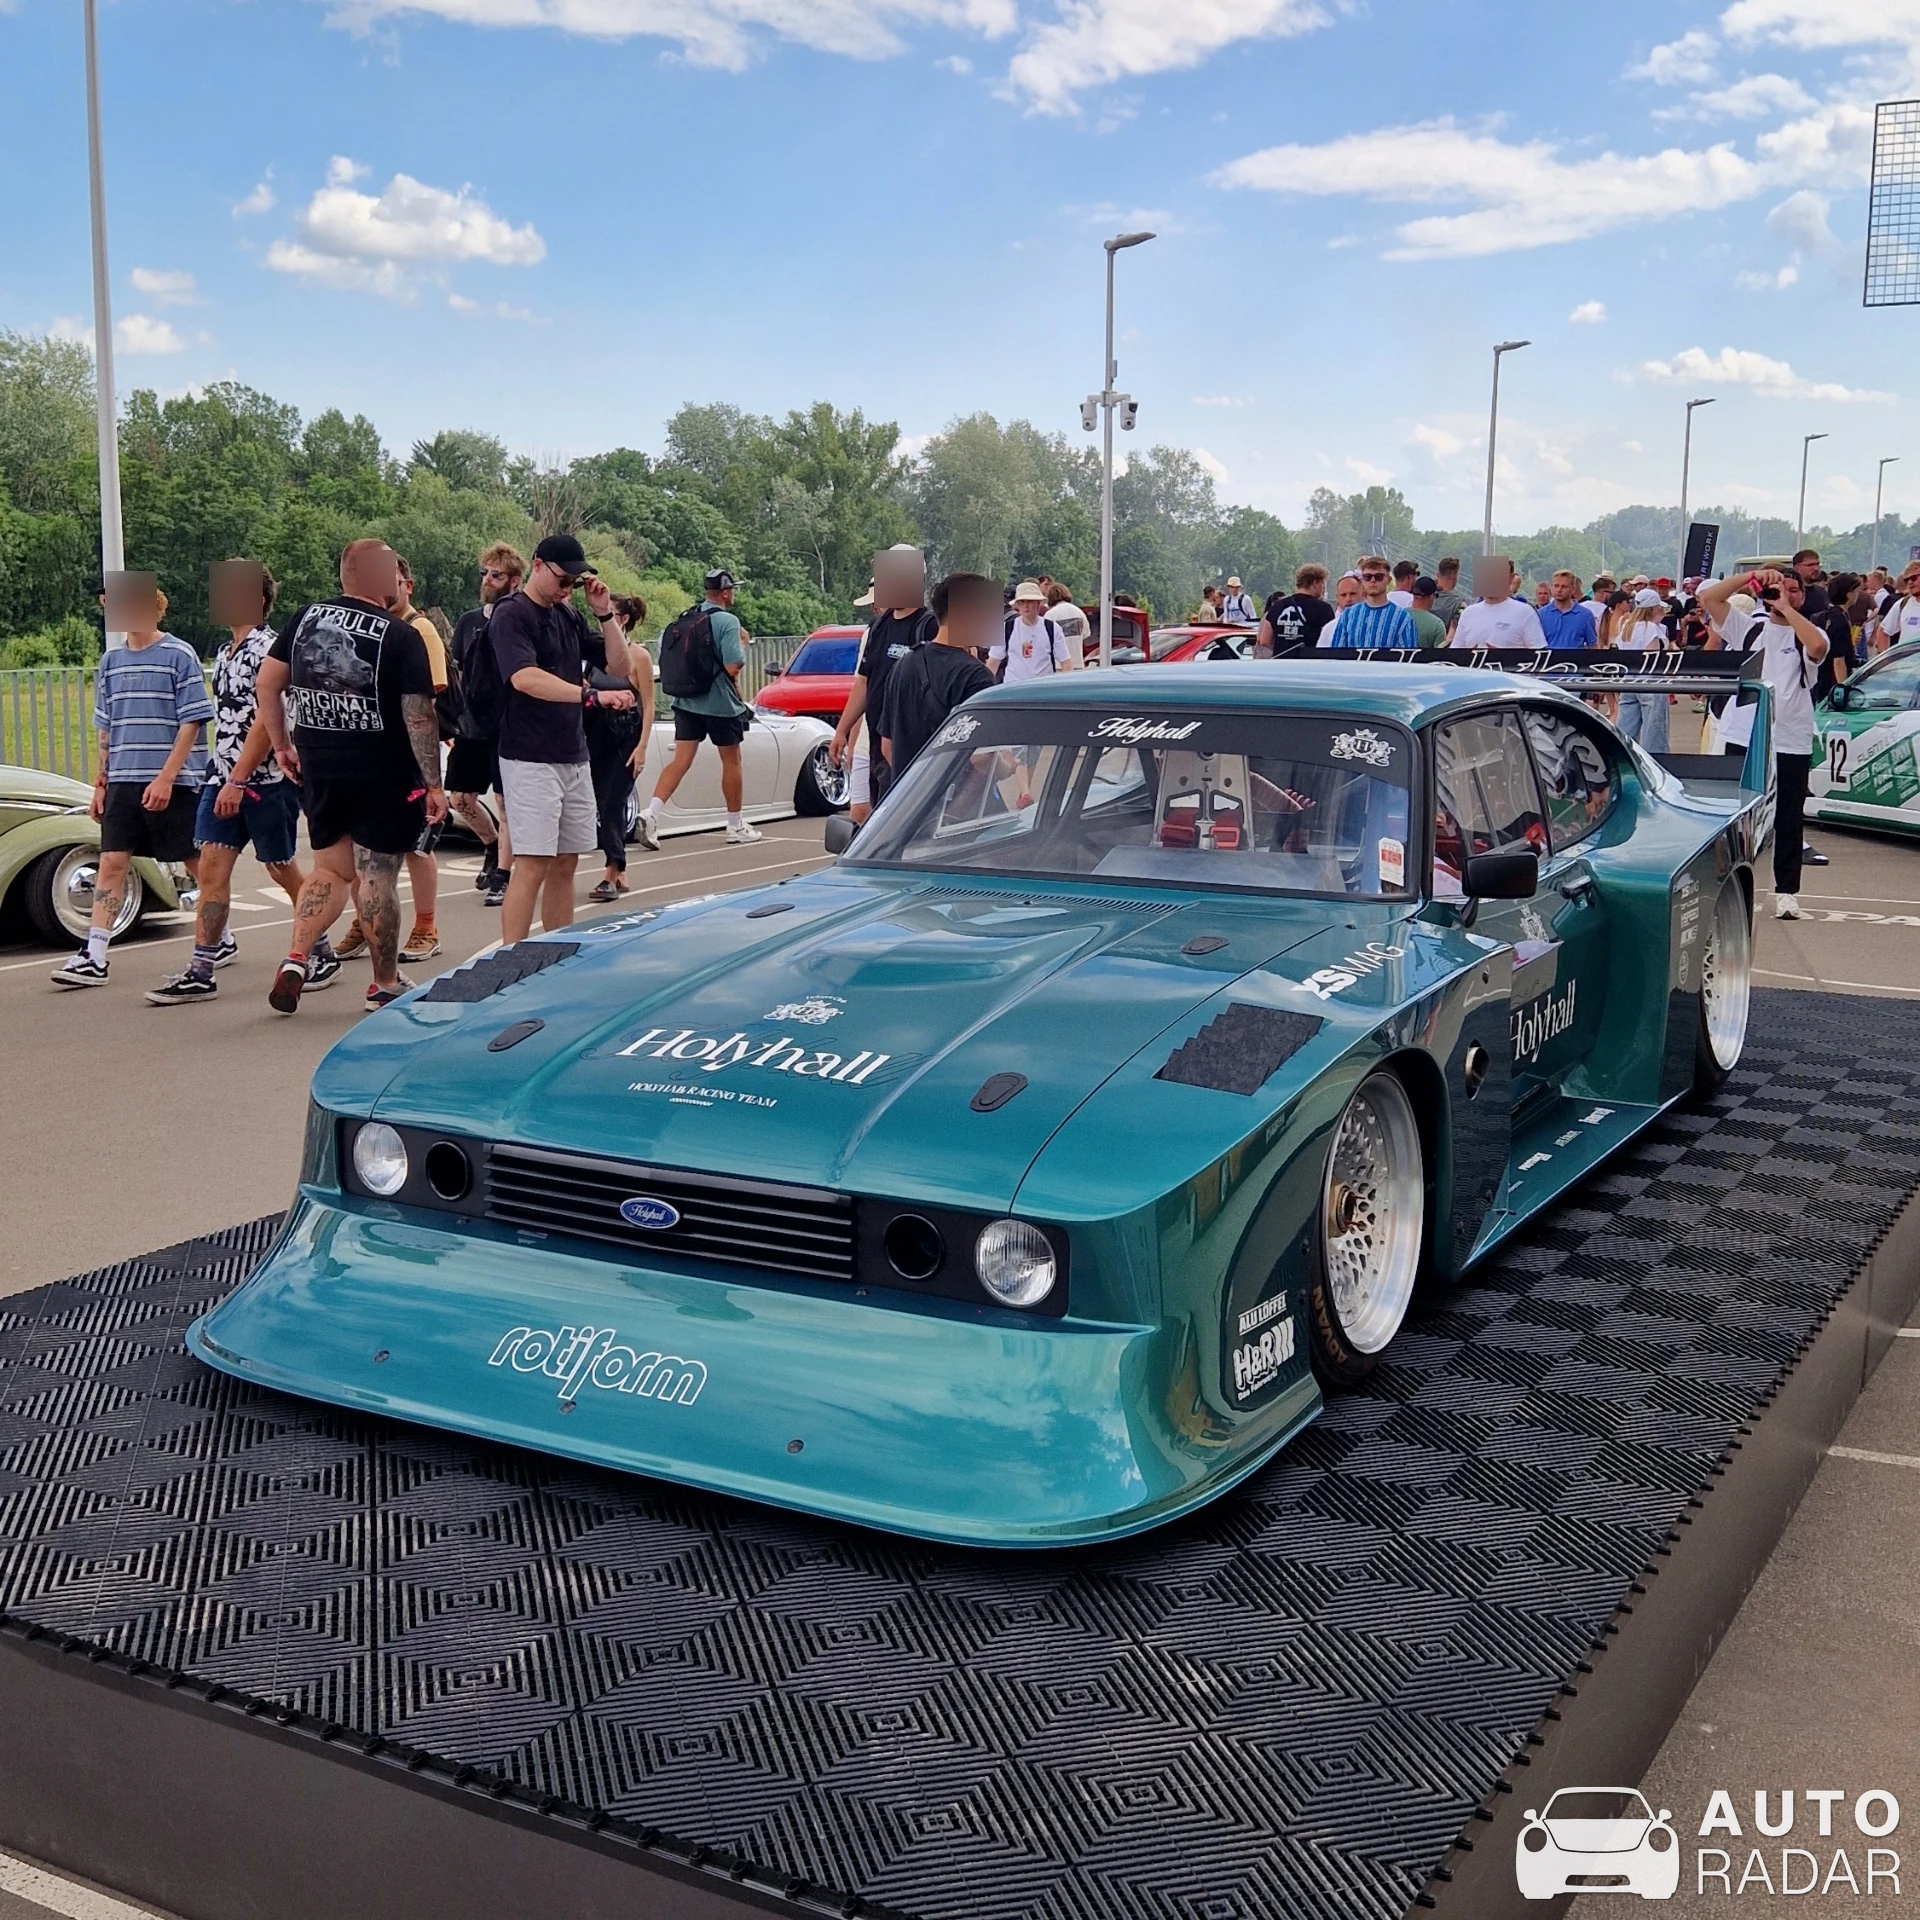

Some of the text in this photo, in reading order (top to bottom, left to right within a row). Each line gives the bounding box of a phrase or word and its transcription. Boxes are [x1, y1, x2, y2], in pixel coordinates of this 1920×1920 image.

[1700, 530, 1714, 578] IREWORK
[305, 606, 380, 637] PITBULL
[1087, 717, 1203, 744] Holyhall
[1830, 738, 1847, 784] 12
[1290, 942, 1407, 1000] XSMAG
[1510, 978, 1576, 1063] Holyhall
[615, 1029, 892, 1085] Holyhall
[686, 1086, 735, 1101] RACING
[738, 1093, 778, 1108] TEAM
[629, 1204, 667, 1222] Holyhall
[488, 1326, 708, 1406] rotiform
